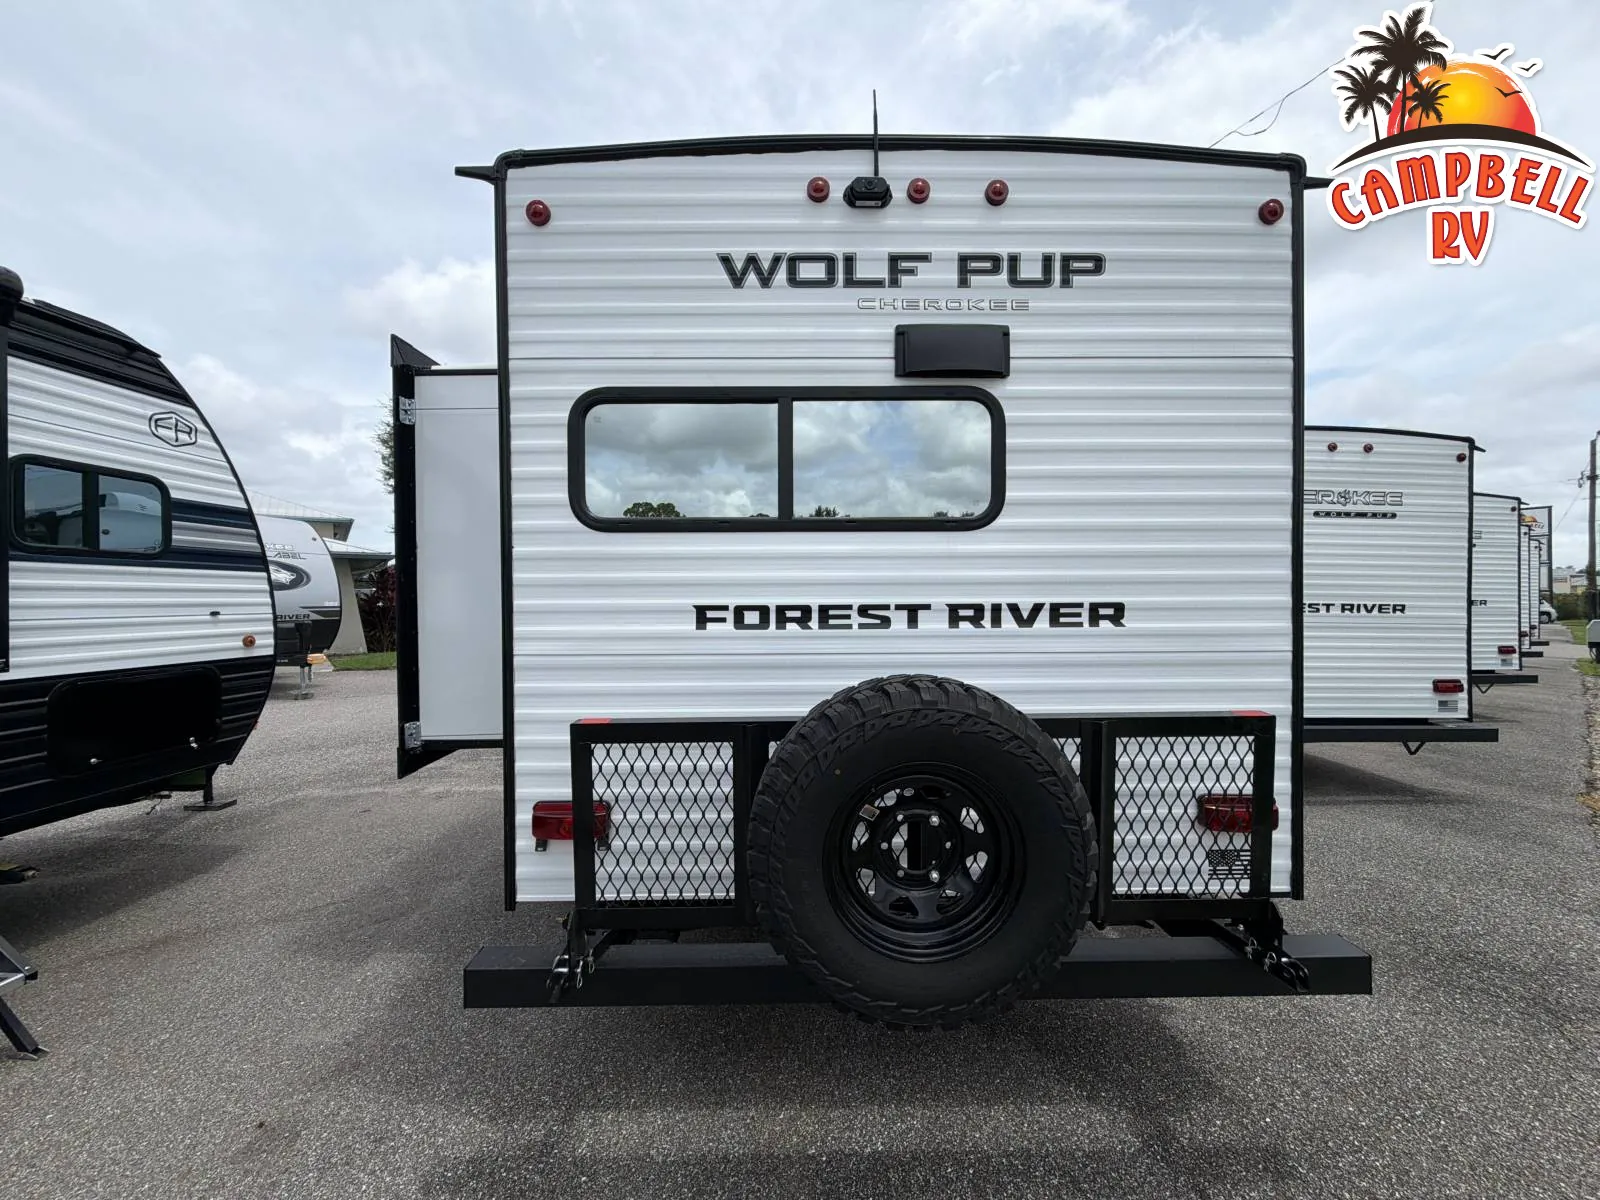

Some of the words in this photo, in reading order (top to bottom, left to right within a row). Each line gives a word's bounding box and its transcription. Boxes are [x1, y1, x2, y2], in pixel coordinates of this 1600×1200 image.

[716, 252, 932, 289] WOLF
[957, 252, 1106, 289] PUP
[857, 297, 1030, 311] CHEROKEE
[692, 603, 931, 630] FOREST
[944, 602, 1127, 628] RIVER
[1340, 603, 1406, 614] RIVER
